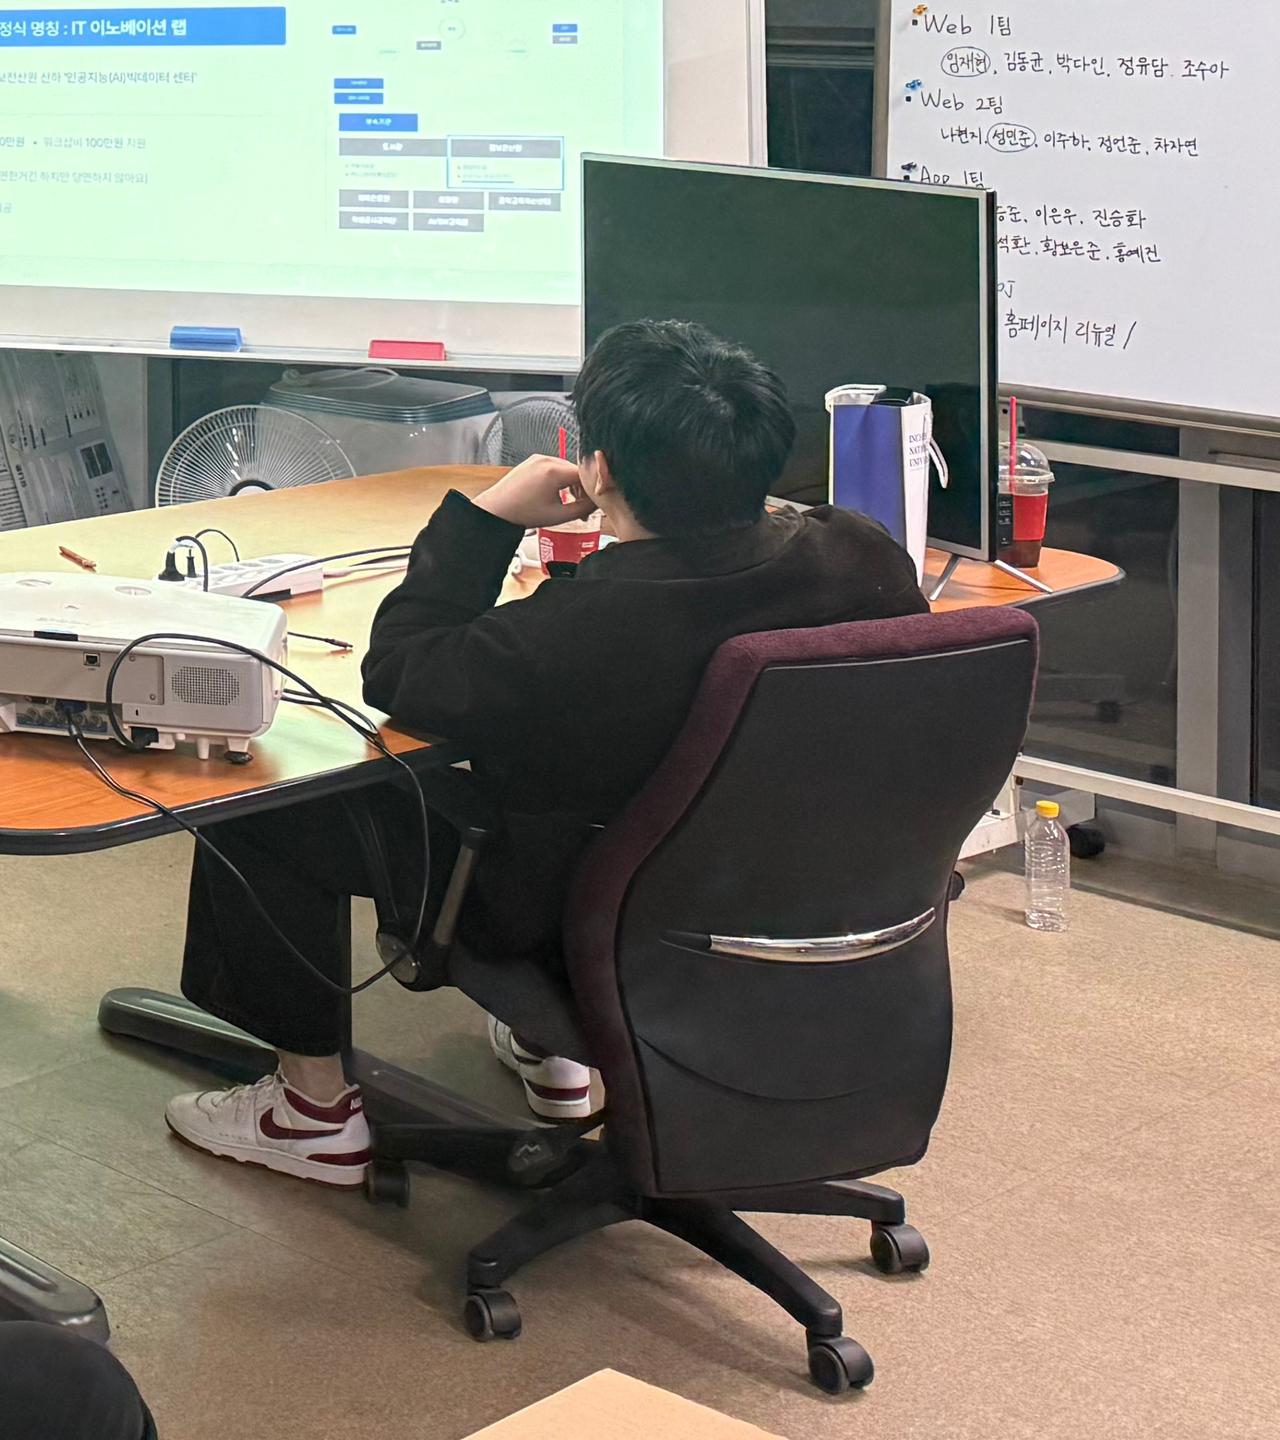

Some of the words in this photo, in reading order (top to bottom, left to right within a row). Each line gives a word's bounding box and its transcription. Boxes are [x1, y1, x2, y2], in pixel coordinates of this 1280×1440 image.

[30, 20, 59, 37] 명칭
[71, 21, 85, 35] IT
[90, 19, 166, 37] 이노베이션
[171, 19, 187, 36] 랩
[924, 14, 972, 35] Web
[990, 15, 1011, 36] 1팀
[41, 72, 61, 84] 산하
[1181, 60, 1230, 81] 조수아
[921, 88, 965, 111] Web
[976, 95, 1004, 115] 2팀
[85, 137, 124, 149] 100만원
[1154, 137, 1198, 157] 차자연
[1093, 208, 1146, 229] 진승화
[1113, 242, 1161, 264] 홍예진
[1004, 309, 1067, 344] 홈페이지
[1076, 320, 1118, 348] 리뉴얼
